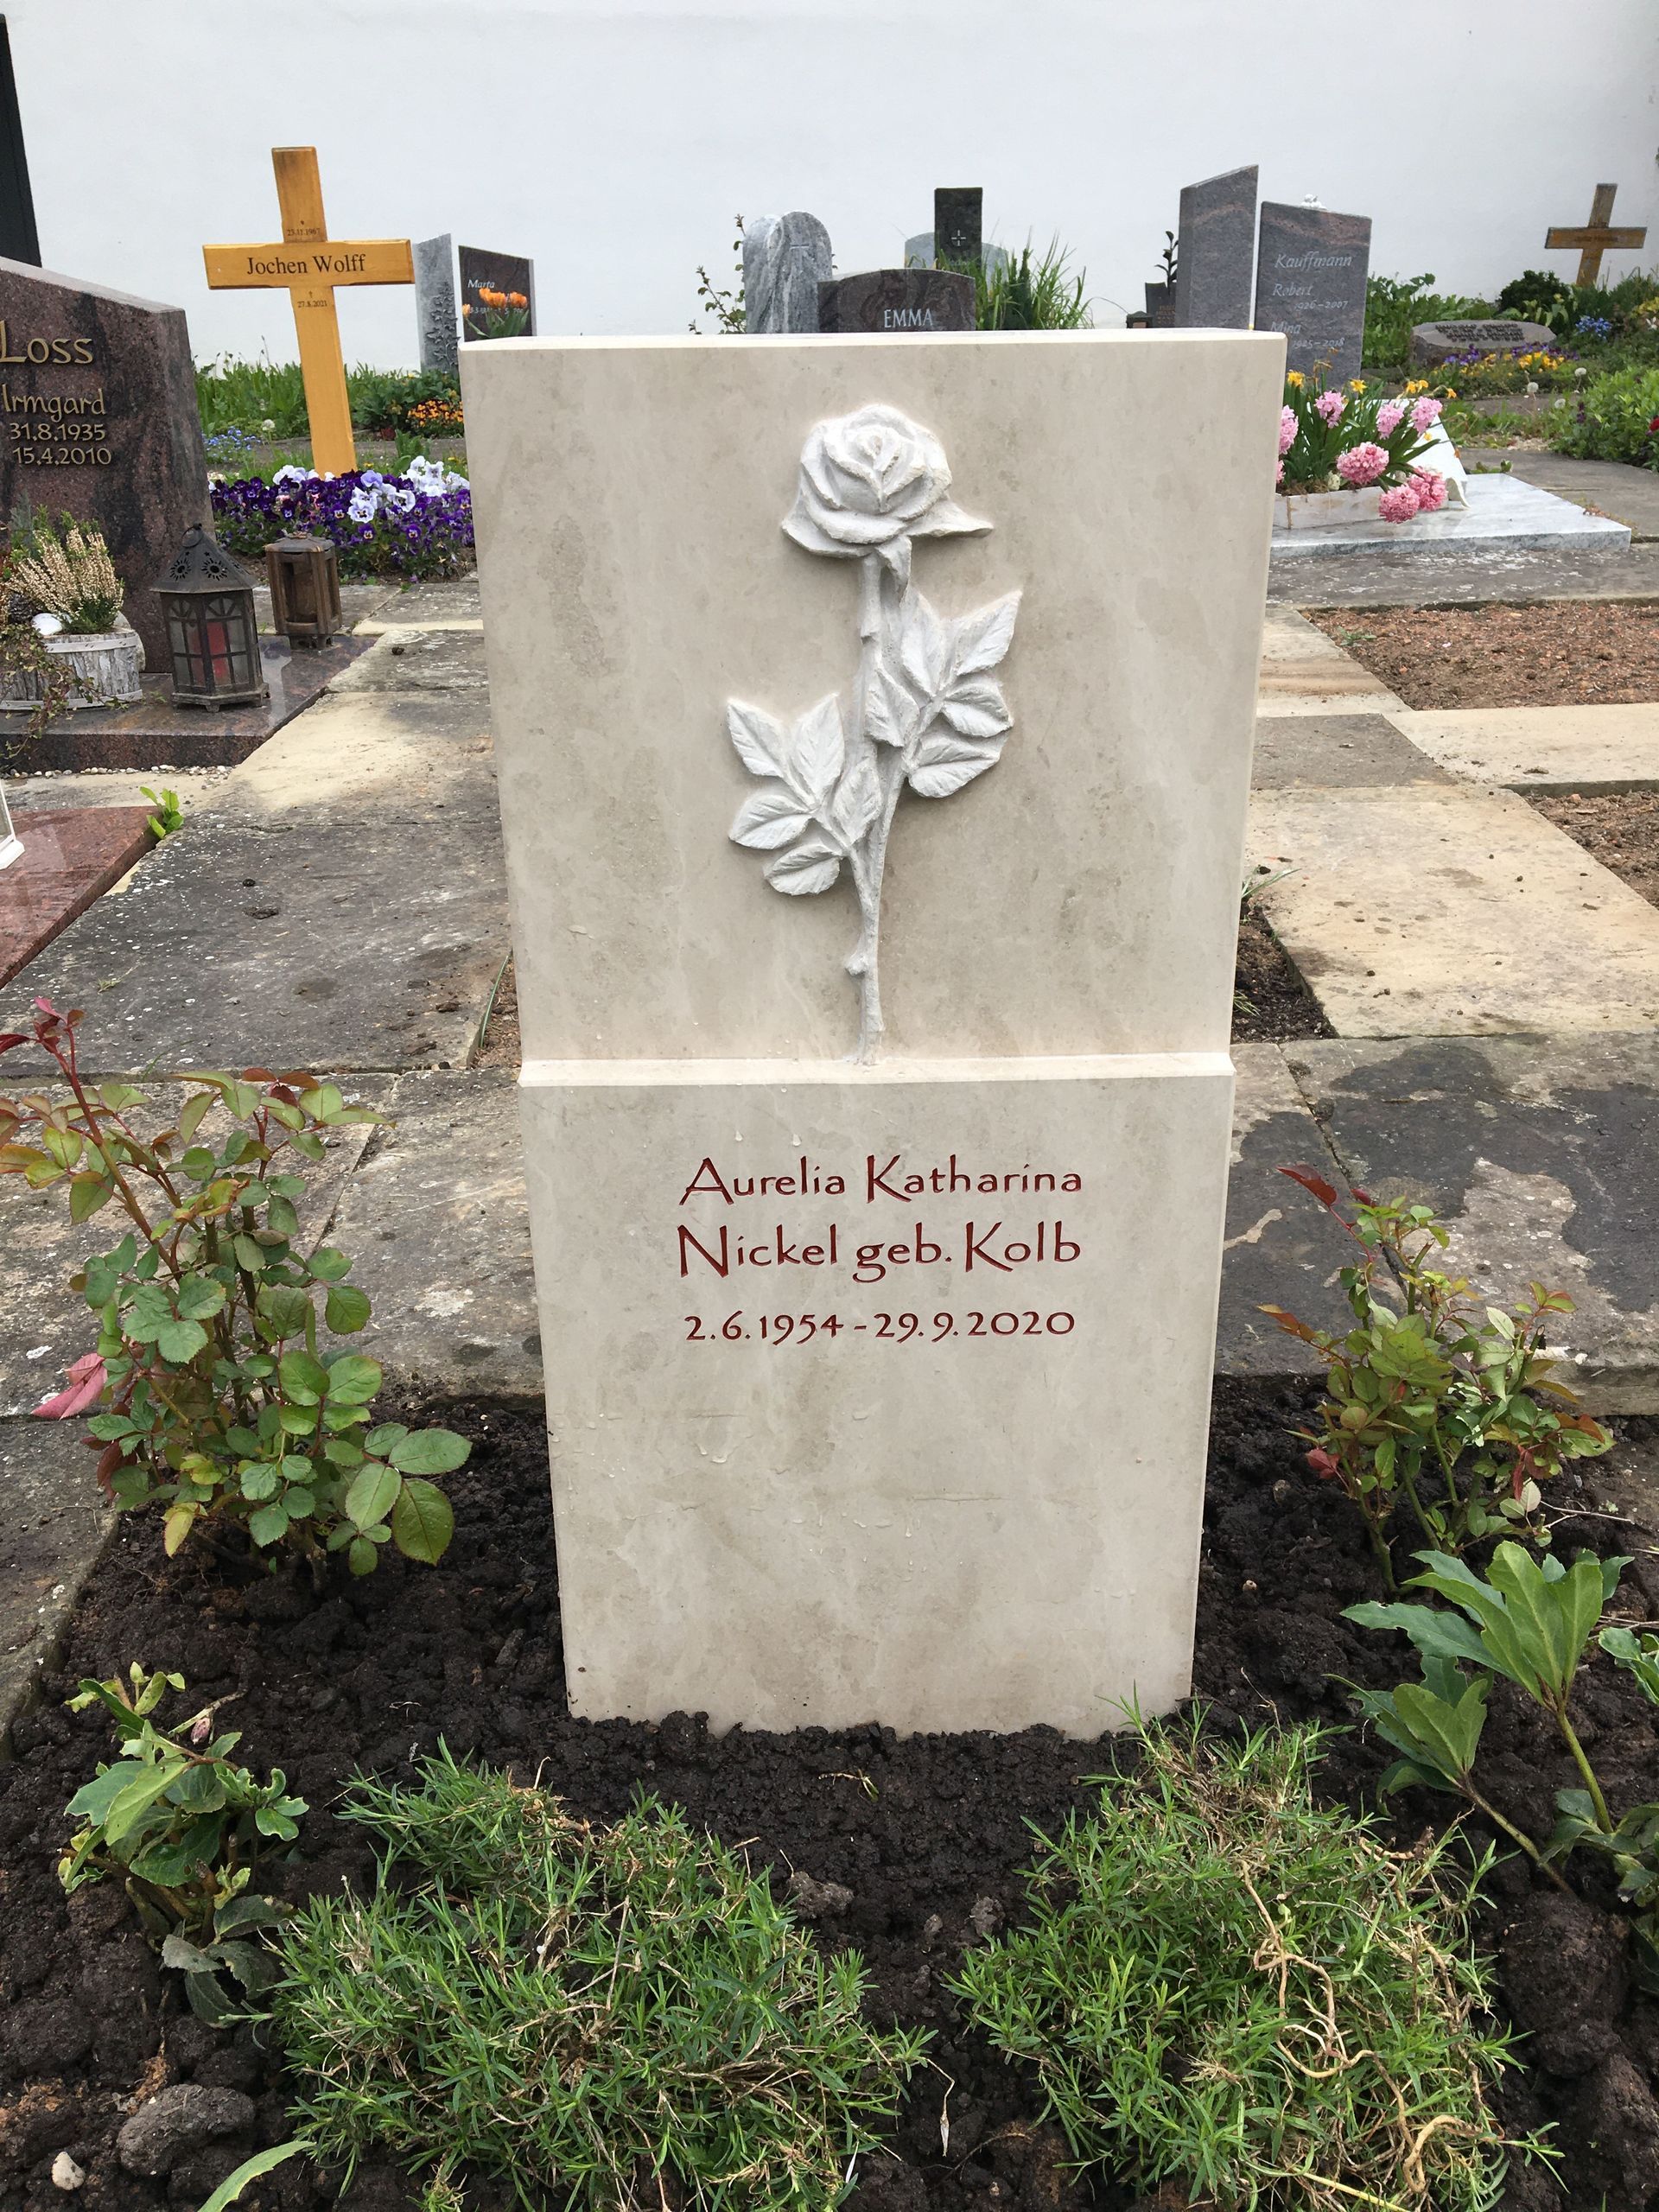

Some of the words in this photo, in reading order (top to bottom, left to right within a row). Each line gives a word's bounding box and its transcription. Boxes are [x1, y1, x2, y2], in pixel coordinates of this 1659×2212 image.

[247, 257, 308, 275] Jochen
[312, 253, 366, 273] Wolff
[1274, 251, 1352, 271] Kauffmann
[467, 279, 495, 289] Marta
[1272, 283, 1313, 296] Robert
[883, 308, 933, 328] EMMA
[0, 320, 93, 364] Loss
[3, 383, 106, 423] Irmgard
[10, 423, 105, 442] 31.8.1935
[13, 447, 112, 466] 15.4.2010
[679, 1155, 846, 1205] Aurelia
[866, 1154, 1083, 1204] Katharina
[677, 1222, 838, 1279] Nickel
[852, 1221, 953, 1284] geb.
[965, 1220, 1082, 1273] Kolb
